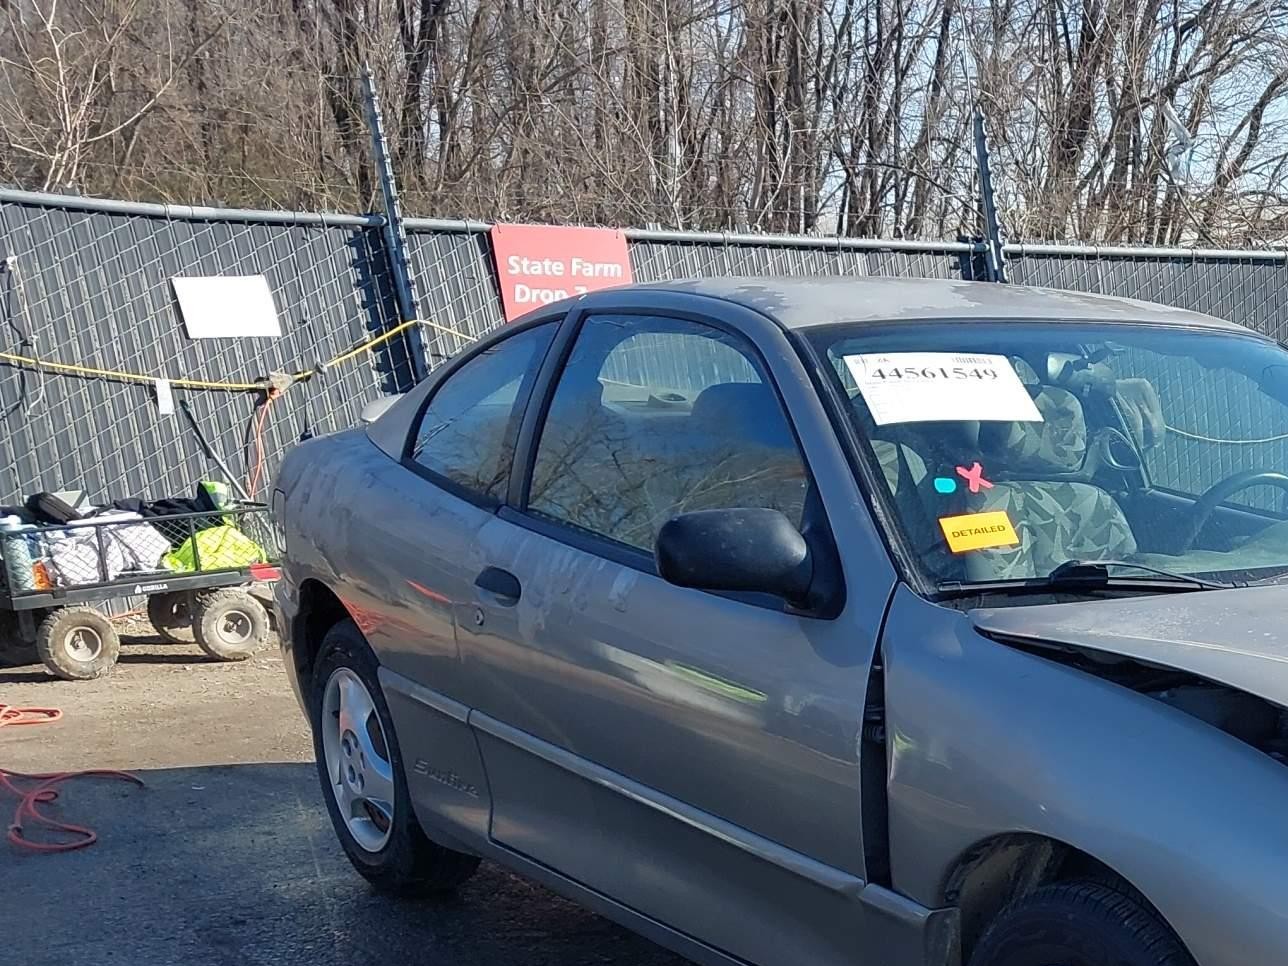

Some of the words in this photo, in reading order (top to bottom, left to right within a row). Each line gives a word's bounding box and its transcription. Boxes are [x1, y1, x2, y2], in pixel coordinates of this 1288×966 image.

[507, 255, 565, 276] State
[571, 257, 622, 278] Farm
[871, 366, 999, 380] 44561549
[951, 524, 1006, 538] DETAILED
